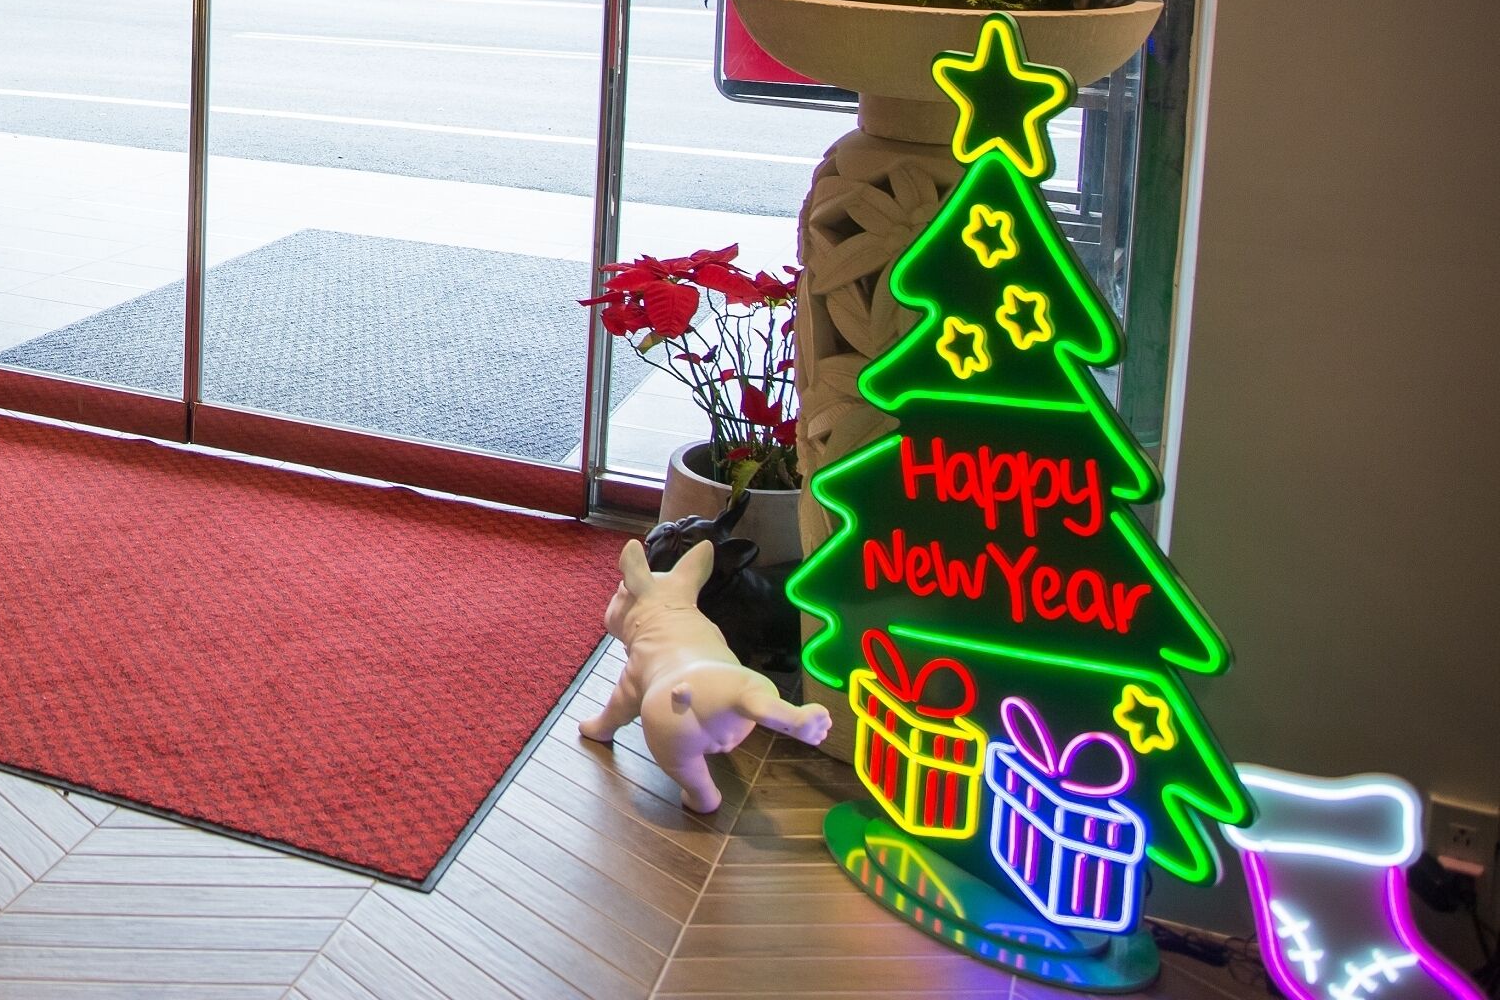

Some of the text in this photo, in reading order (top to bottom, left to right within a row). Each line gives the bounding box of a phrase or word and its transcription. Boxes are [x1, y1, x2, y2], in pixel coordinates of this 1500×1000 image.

[900, 435, 1104, 538] Happy
[862, 528, 1153, 635] New Year
